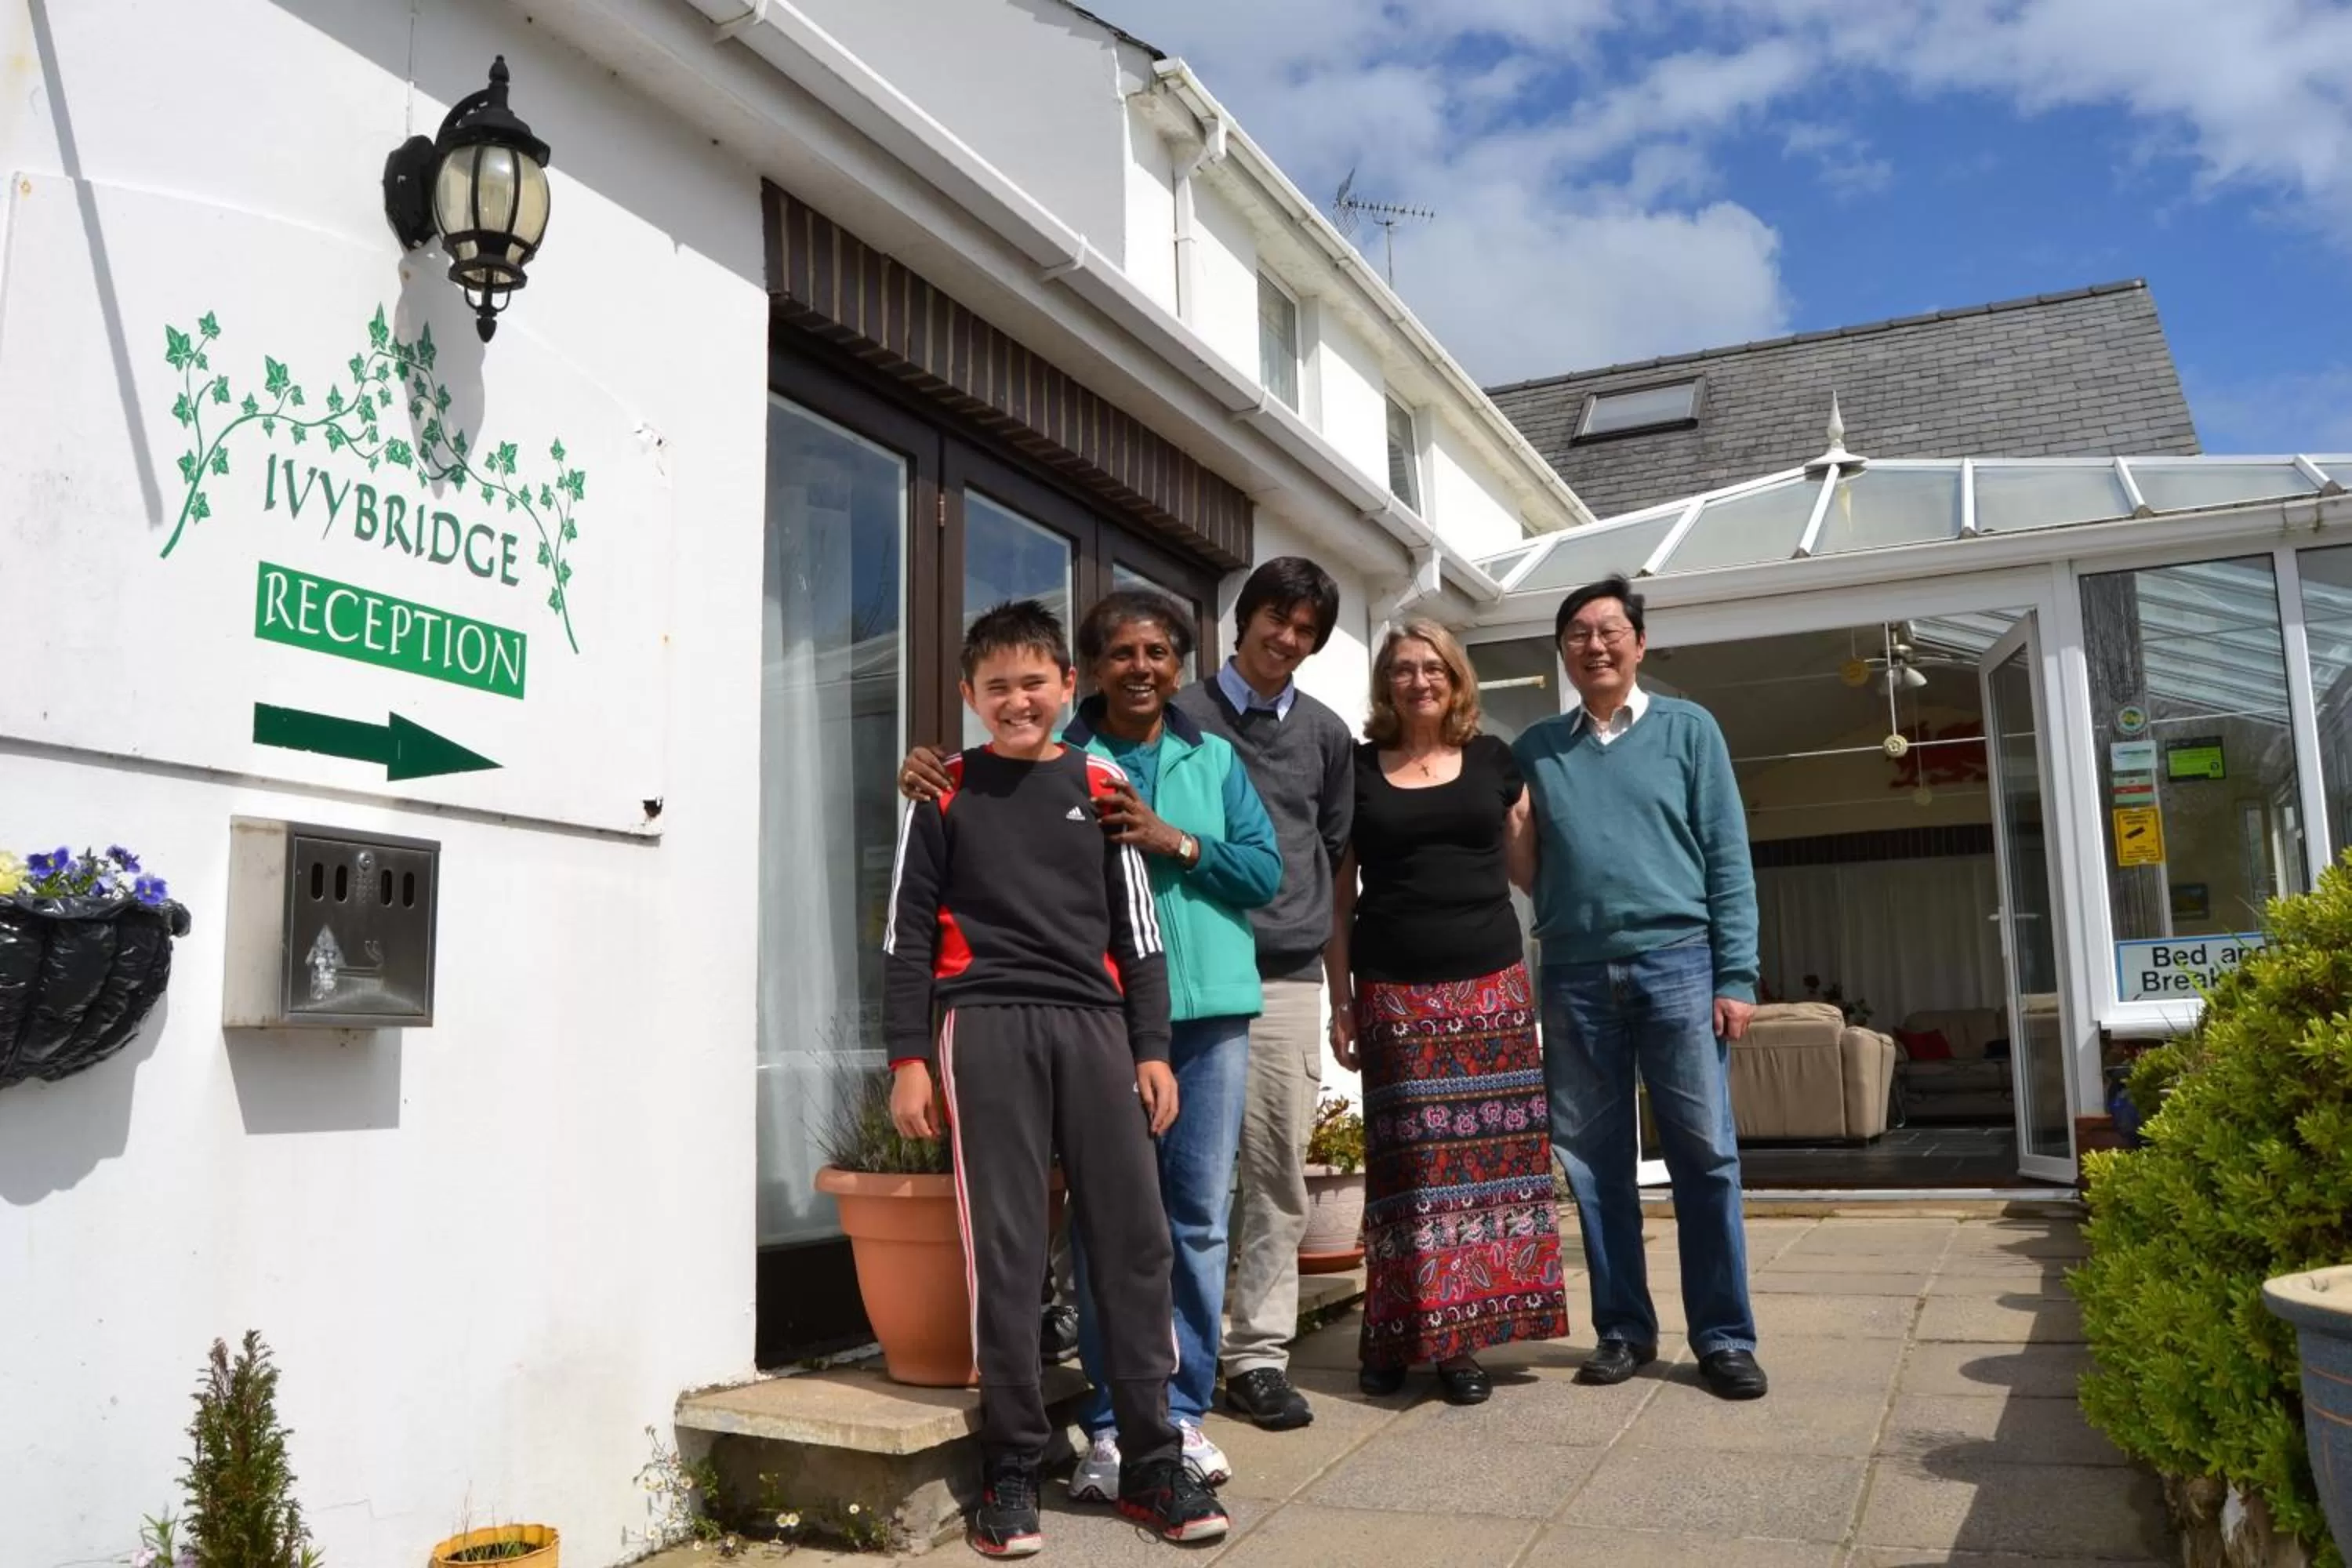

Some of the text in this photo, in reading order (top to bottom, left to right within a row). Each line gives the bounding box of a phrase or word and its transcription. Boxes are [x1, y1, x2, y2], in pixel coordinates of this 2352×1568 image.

[263, 453, 520, 586] IVYBRIDGE
[264, 572, 521, 685] RECEPTION
[2141, 967, 2233, 992] Break
[2151, 943, 2267, 967] Bed an
